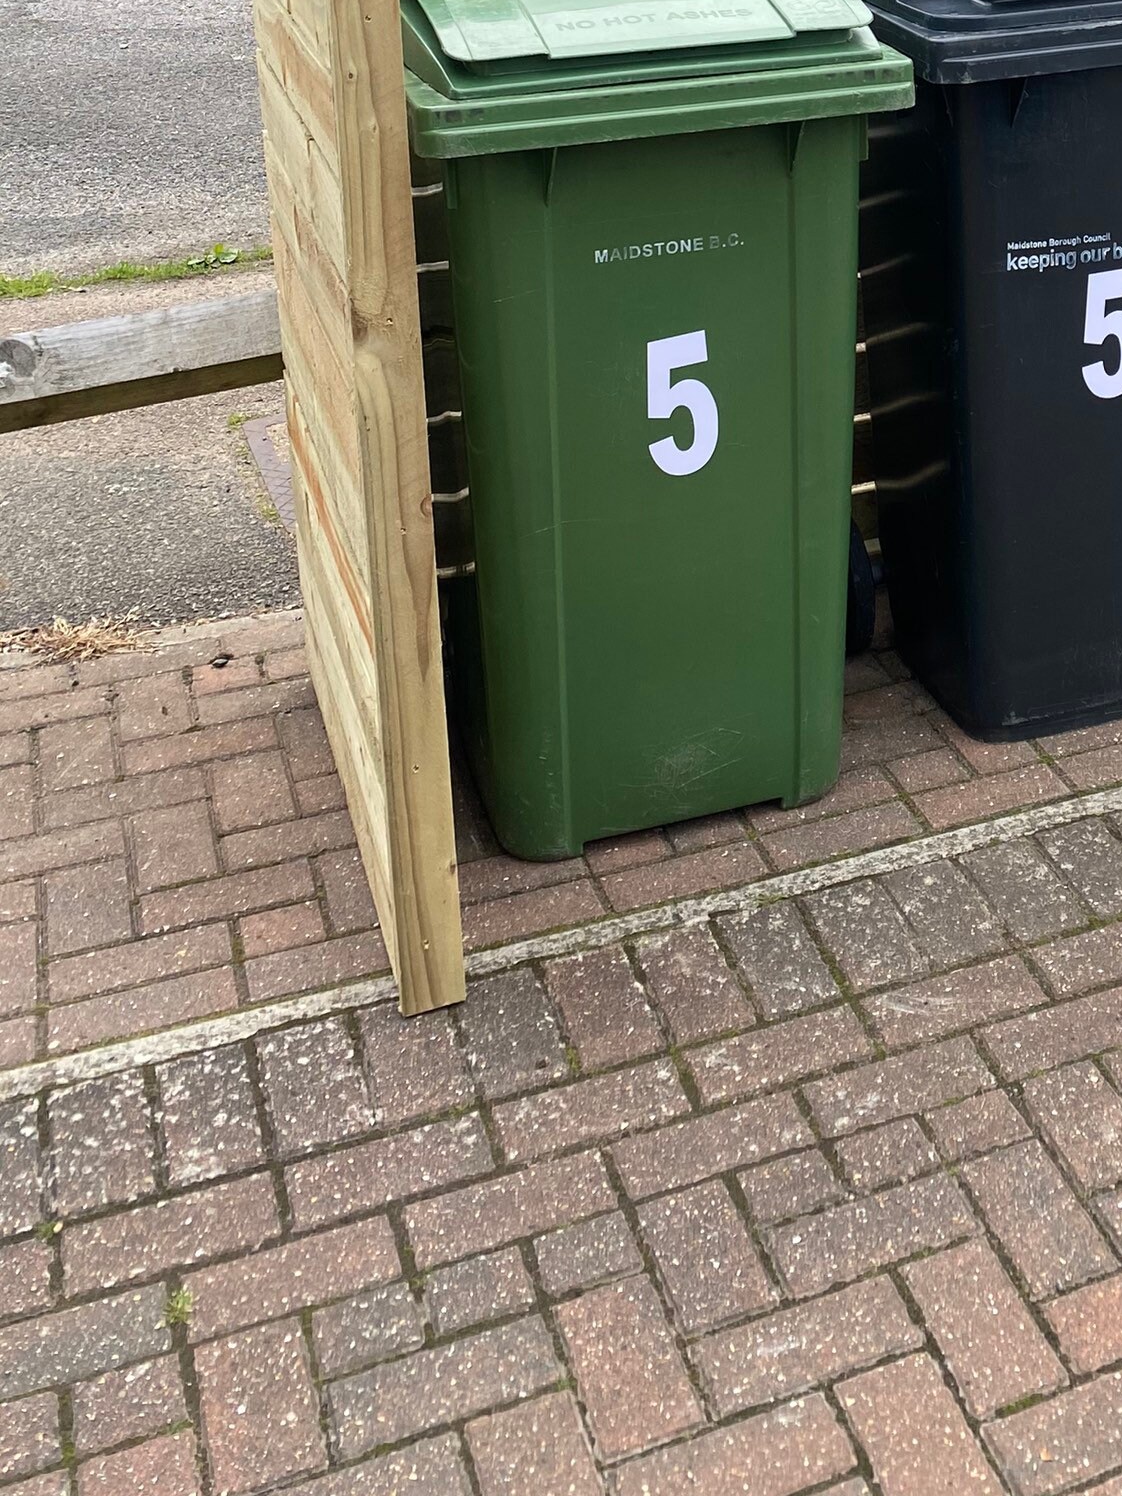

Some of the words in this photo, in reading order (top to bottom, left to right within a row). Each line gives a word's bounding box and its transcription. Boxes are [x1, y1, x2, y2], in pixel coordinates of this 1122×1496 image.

[555, 19, 595, 31] NO
[602, 13, 657, 27] HOT
[666, 8, 753, 21] ASHES
[594, 237, 704, 263] MAIDSTONE
[709, 233, 745, 249] B.C.
[1007, 239, 1047, 250] Maidstone
[1049, 236, 1082, 248] Borough
[1083, 232, 1111, 244] Council
[1006, 248, 1077, 272] keeping
[1080, 247, 1110, 263] our
[647, 330, 719, 476] 5
